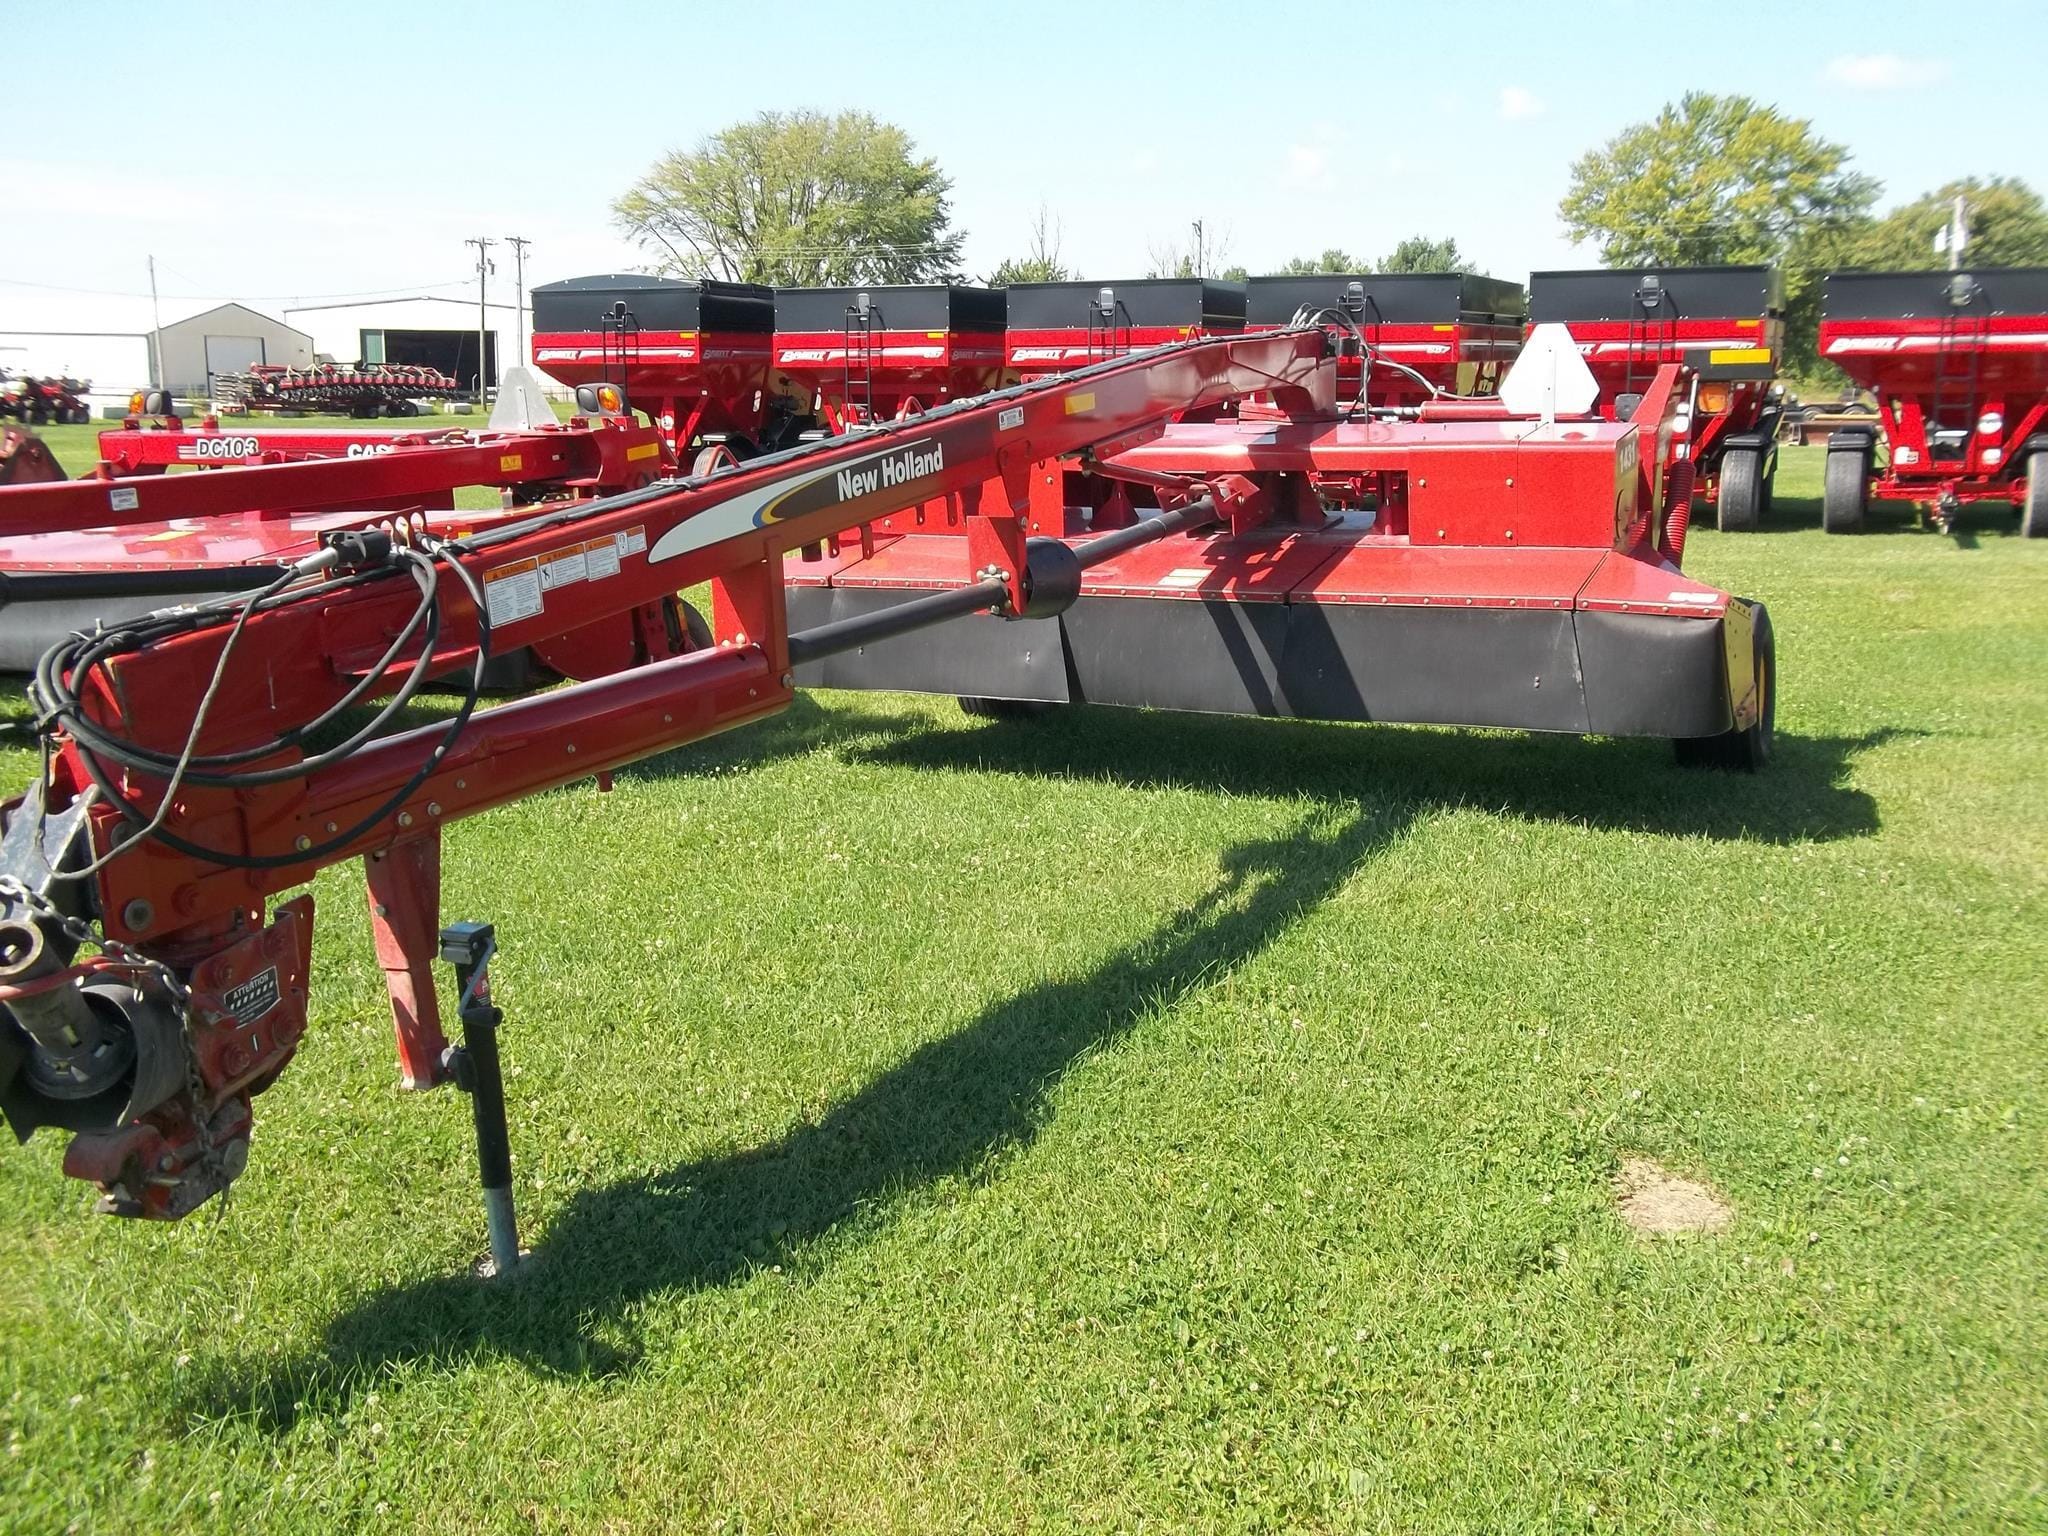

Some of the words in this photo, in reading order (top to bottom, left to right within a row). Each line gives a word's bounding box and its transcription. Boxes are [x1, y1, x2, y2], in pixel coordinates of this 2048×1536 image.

[196, 437, 259, 458] DC103
[837, 469, 878, 502] New
[881, 442, 944, 488] Holland
[233, 972, 269, 1000] ATTENTION
